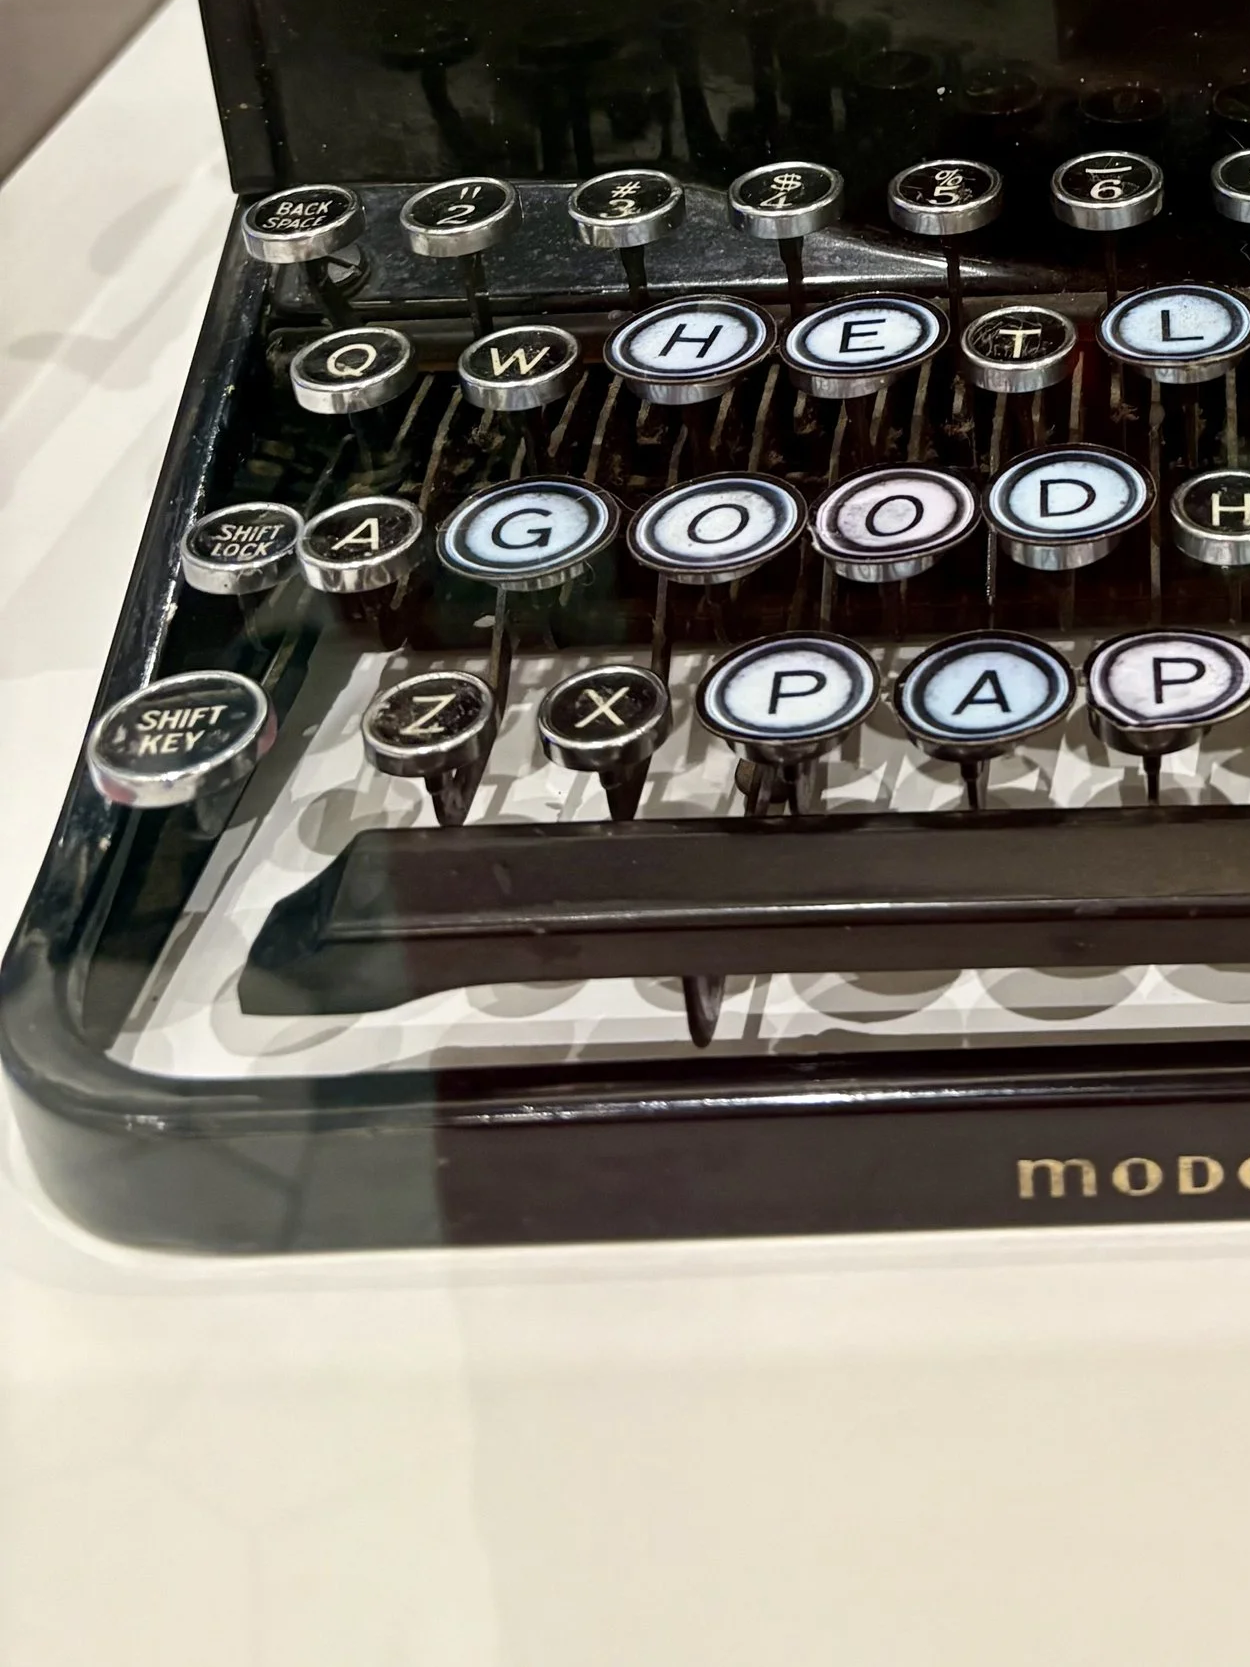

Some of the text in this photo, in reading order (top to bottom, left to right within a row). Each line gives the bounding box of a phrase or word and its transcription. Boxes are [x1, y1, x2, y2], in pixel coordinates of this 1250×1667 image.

[611, 181, 641, 198] #
[770, 173, 802, 192] $
[934, 167, 963, 186] %
[1089, 179, 1123, 201] 6
[275, 200, 332, 217] BACK
[600, 199, 637, 218] 3
[760, 191, 793, 208] 4
[928, 185, 960, 206] 5
[261, 214, 323, 230] SPACE
[436, 204, 474, 226] 2
[657, 323, 724, 358] H
[838, 318, 887, 354] E
[1160, 309, 1205, 343] L
[999, 328, 1042, 359] T
[326, 343, 378, 378] Q
[489, 346, 551, 377] W
[1039, 478, 1096, 518] D
[490, 507, 553, 549] G
[687, 503, 750, 544] O
[865, 493, 924, 536] O
[216, 522, 283, 543] SHIFT
[330, 517, 381, 551] A
[210, 540, 273, 559] LOCK
[767, 669, 827, 715] P
[952, 668, 1013, 715] A
[1152, 656, 1206, 705] P
[136, 704, 229, 730] SHIFT
[400, 693, 457, 735] Z
[573, 686, 631, 729] X
[137, 729, 205, 756] KEY
